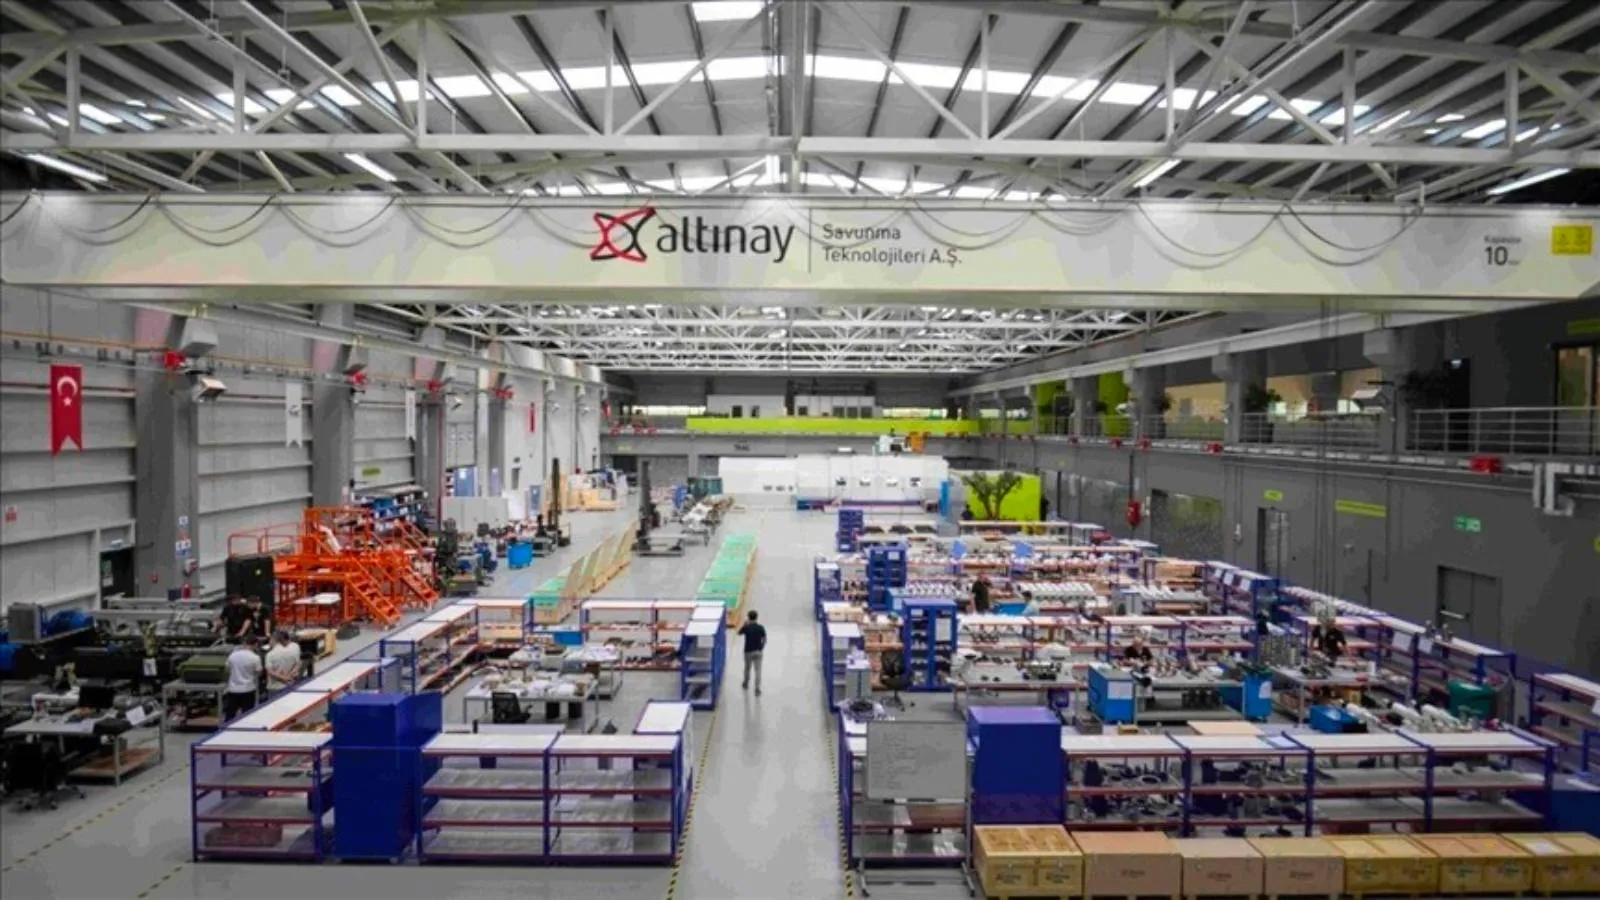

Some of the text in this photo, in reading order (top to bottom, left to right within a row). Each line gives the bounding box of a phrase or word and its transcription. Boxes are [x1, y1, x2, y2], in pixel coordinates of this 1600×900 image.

[822, 223, 902, 240] Savunma
[822, 245, 925, 266] Teknolojileri
[1484, 245, 1508, 266] 10
